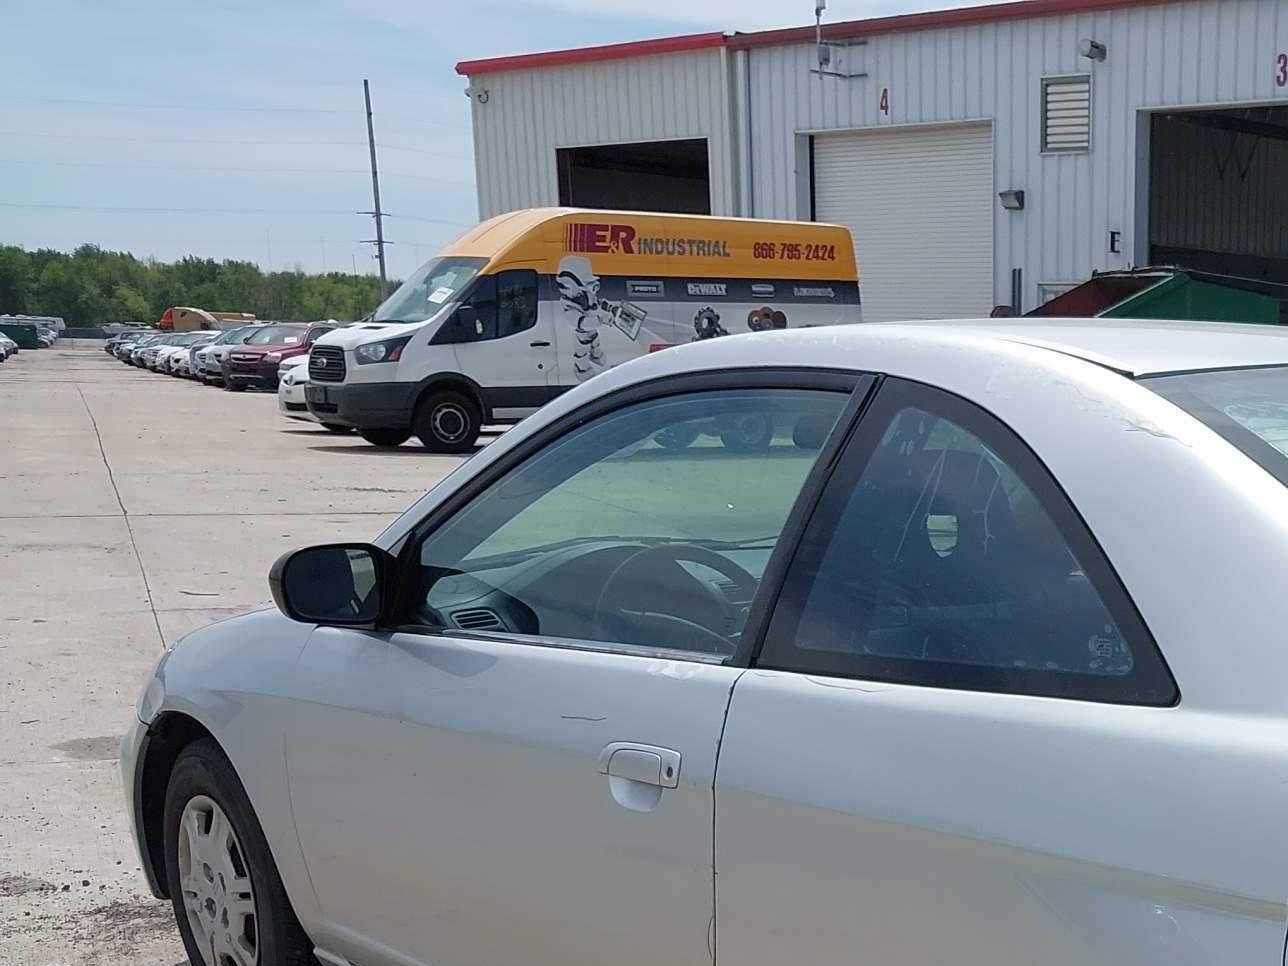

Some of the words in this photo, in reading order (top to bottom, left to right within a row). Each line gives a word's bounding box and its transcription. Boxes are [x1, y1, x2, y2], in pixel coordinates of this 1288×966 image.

[1276, 53, 1288, 87] 3
[880, 88, 889, 116] 4
[580, 223, 636, 254] E&R
[638, 238, 730, 257] INDUSTRIAL
